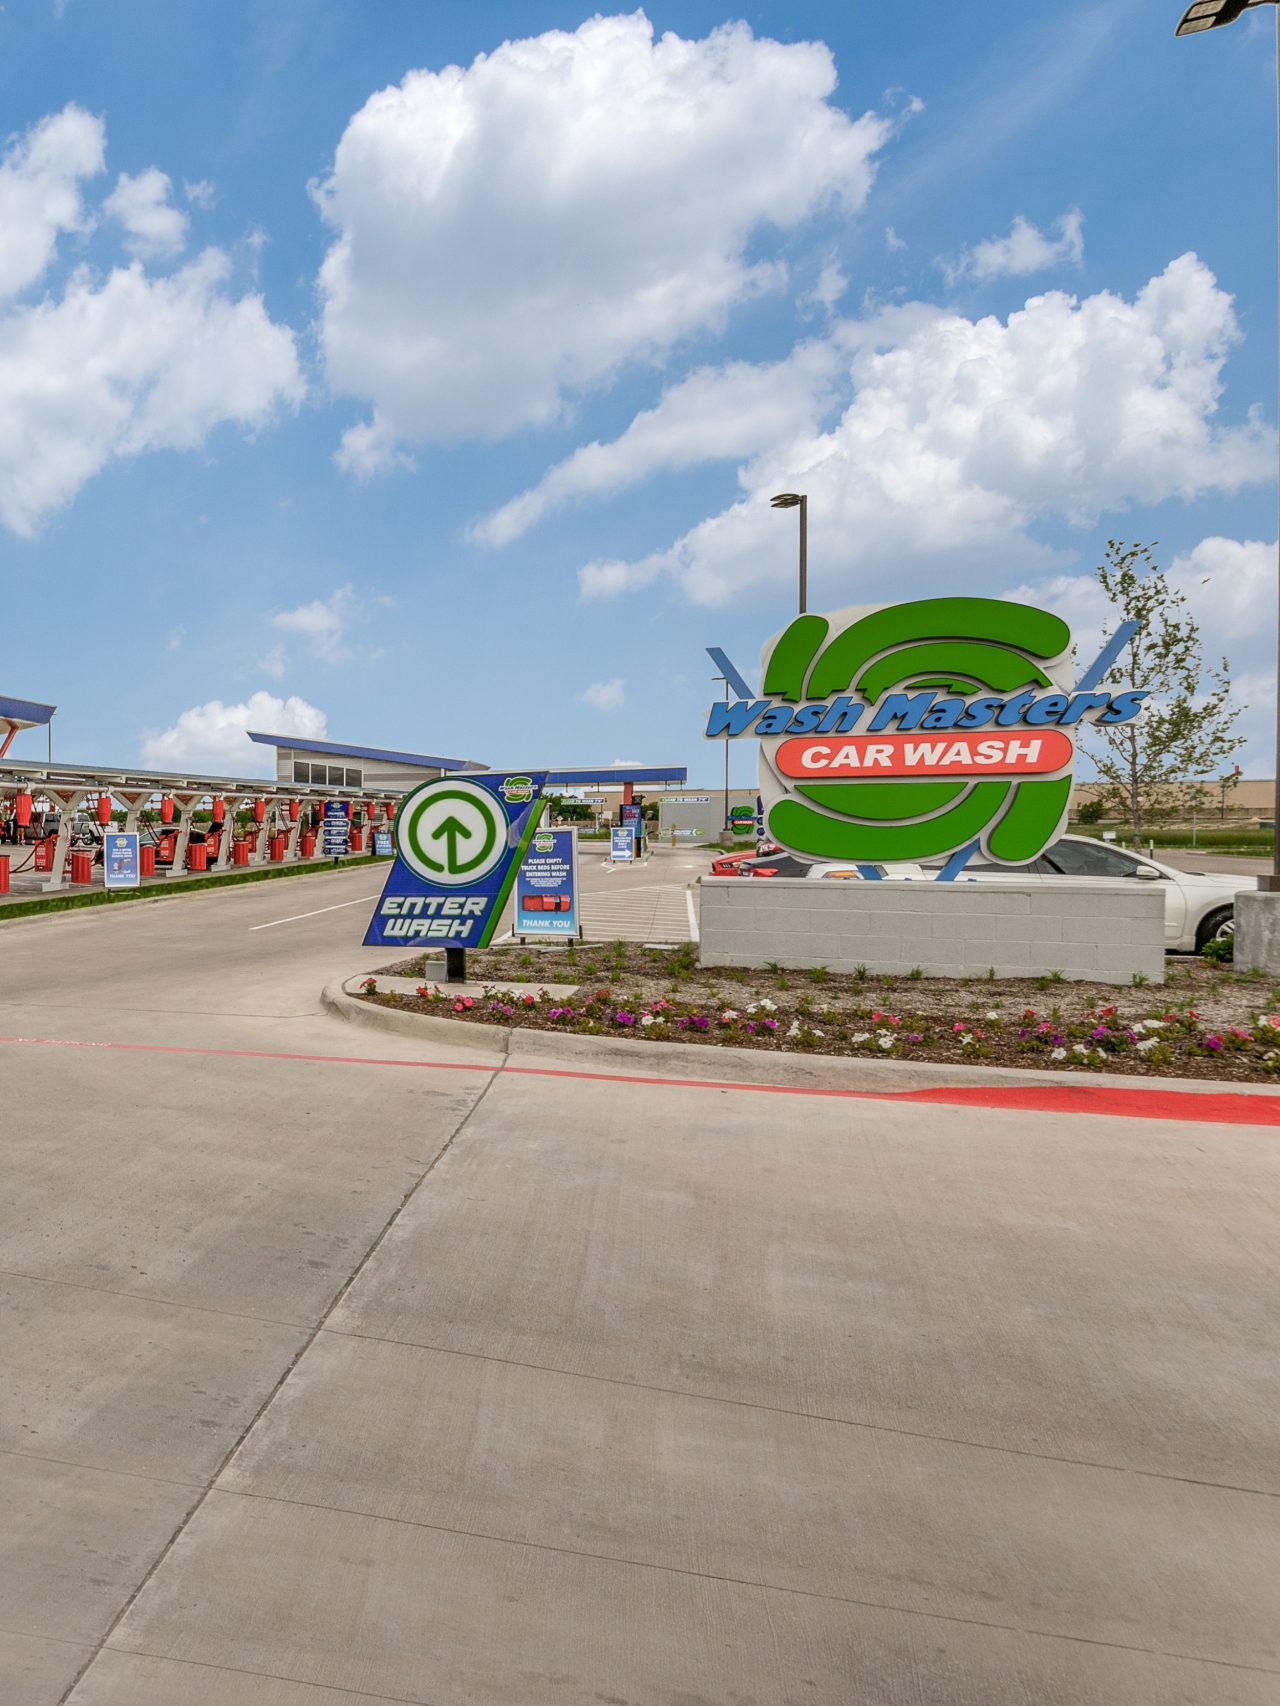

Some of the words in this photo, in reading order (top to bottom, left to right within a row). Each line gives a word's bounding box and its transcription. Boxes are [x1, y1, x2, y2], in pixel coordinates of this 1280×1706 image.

[706, 696, 864, 737] Wash
[867, 687, 1148, 732] Masters
[800, 744, 894, 769] CAR
[902, 739, 1043, 765] WASH
[380, 897, 488, 916] ENTER
[383, 919, 474, 937] WASH
